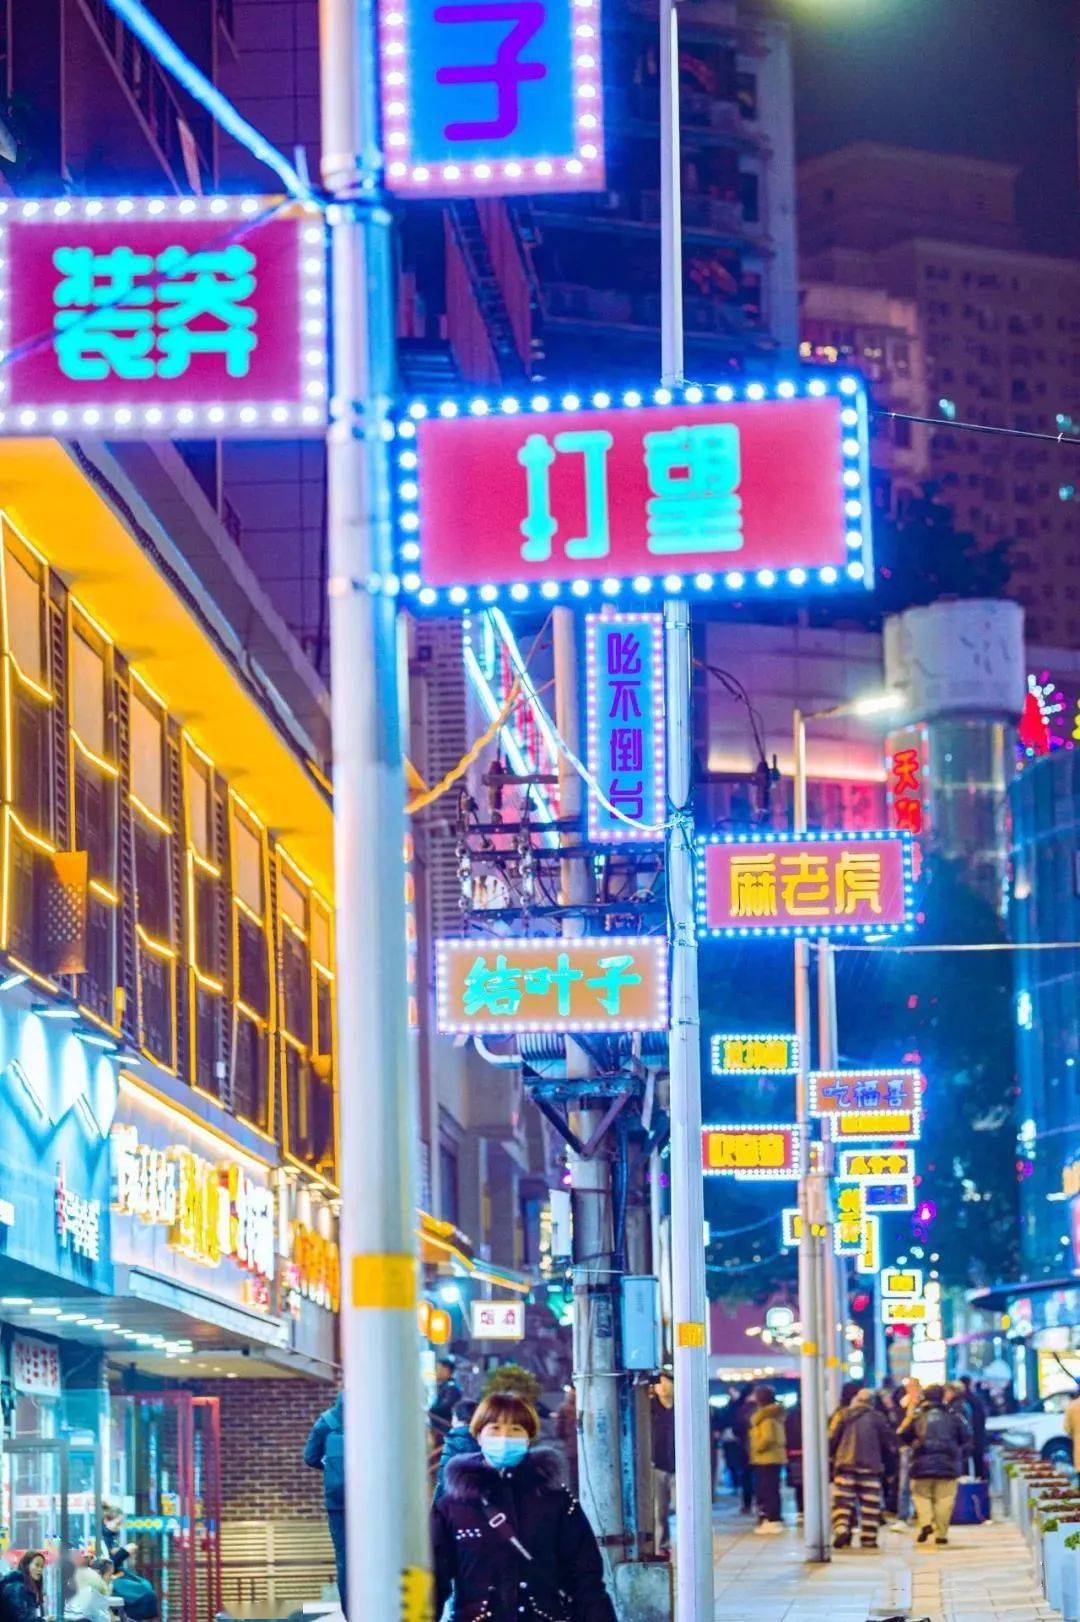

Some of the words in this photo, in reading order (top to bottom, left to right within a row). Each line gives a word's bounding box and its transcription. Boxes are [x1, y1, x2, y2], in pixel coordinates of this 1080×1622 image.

[434, 1, 547, 142] 子
[516, 422, 744, 562] 打望
[730, 851, 882, 916] 麻老虎
[462, 953, 642, 1016] 结叶子
